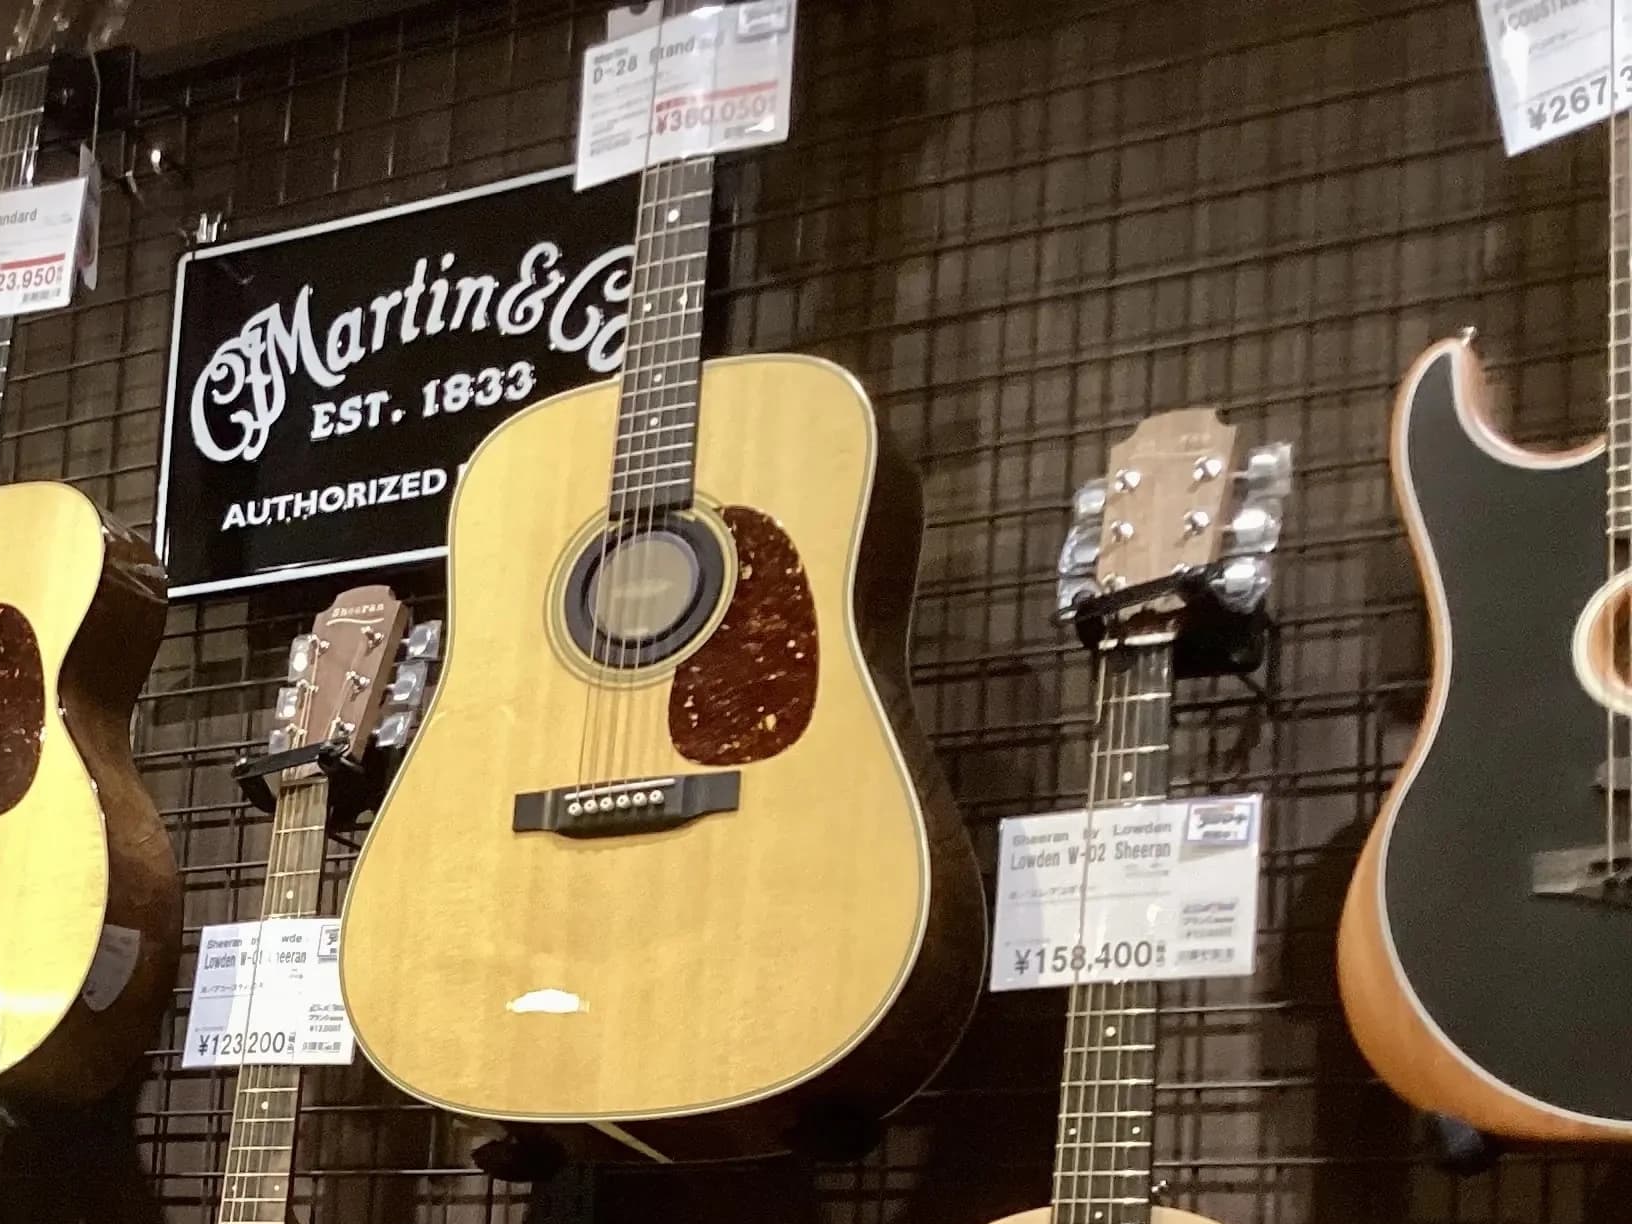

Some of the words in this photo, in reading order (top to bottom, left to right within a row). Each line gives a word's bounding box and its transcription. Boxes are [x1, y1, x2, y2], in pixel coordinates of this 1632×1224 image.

[593, 55, 638, 85] D-28
[310, 390, 407, 441] EST.
[422, 360, 537, 418] 1833
[221, 466, 448, 532] AUTHORIZED
[1113, 821, 1172, 837] Lowden
[1010, 849, 1061, 872] Lowden
[1114, 840, 1171, 861] Sheeran
[204, 953, 236, 970] Lowden
[1014, 940, 1153, 976] ¥158,400
[197, 1030, 287, 1057] ¥123200
